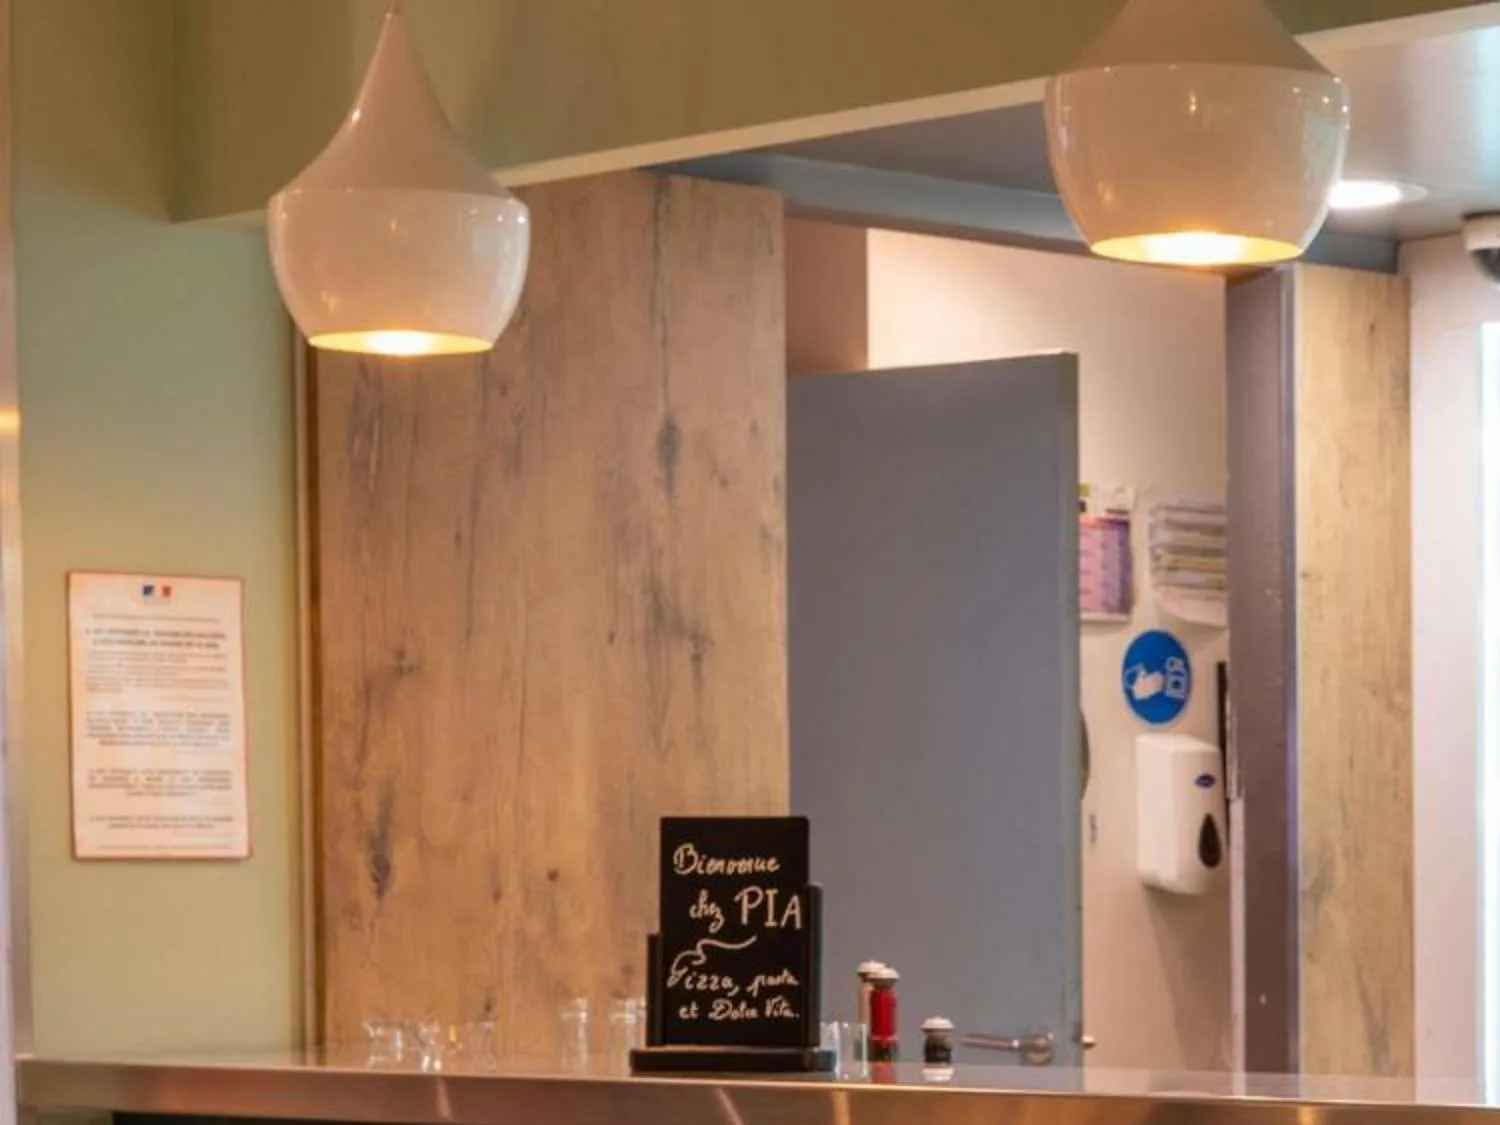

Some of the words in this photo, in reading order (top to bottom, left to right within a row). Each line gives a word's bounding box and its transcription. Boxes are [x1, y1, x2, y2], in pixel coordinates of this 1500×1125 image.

[673, 843, 781, 875] Bienvenue
[689, 889, 725, 934] chez
[734, 885, 802, 930] PIA
[666, 955, 740, 998] Pizza,
[679, 1001, 699, 1019] et
